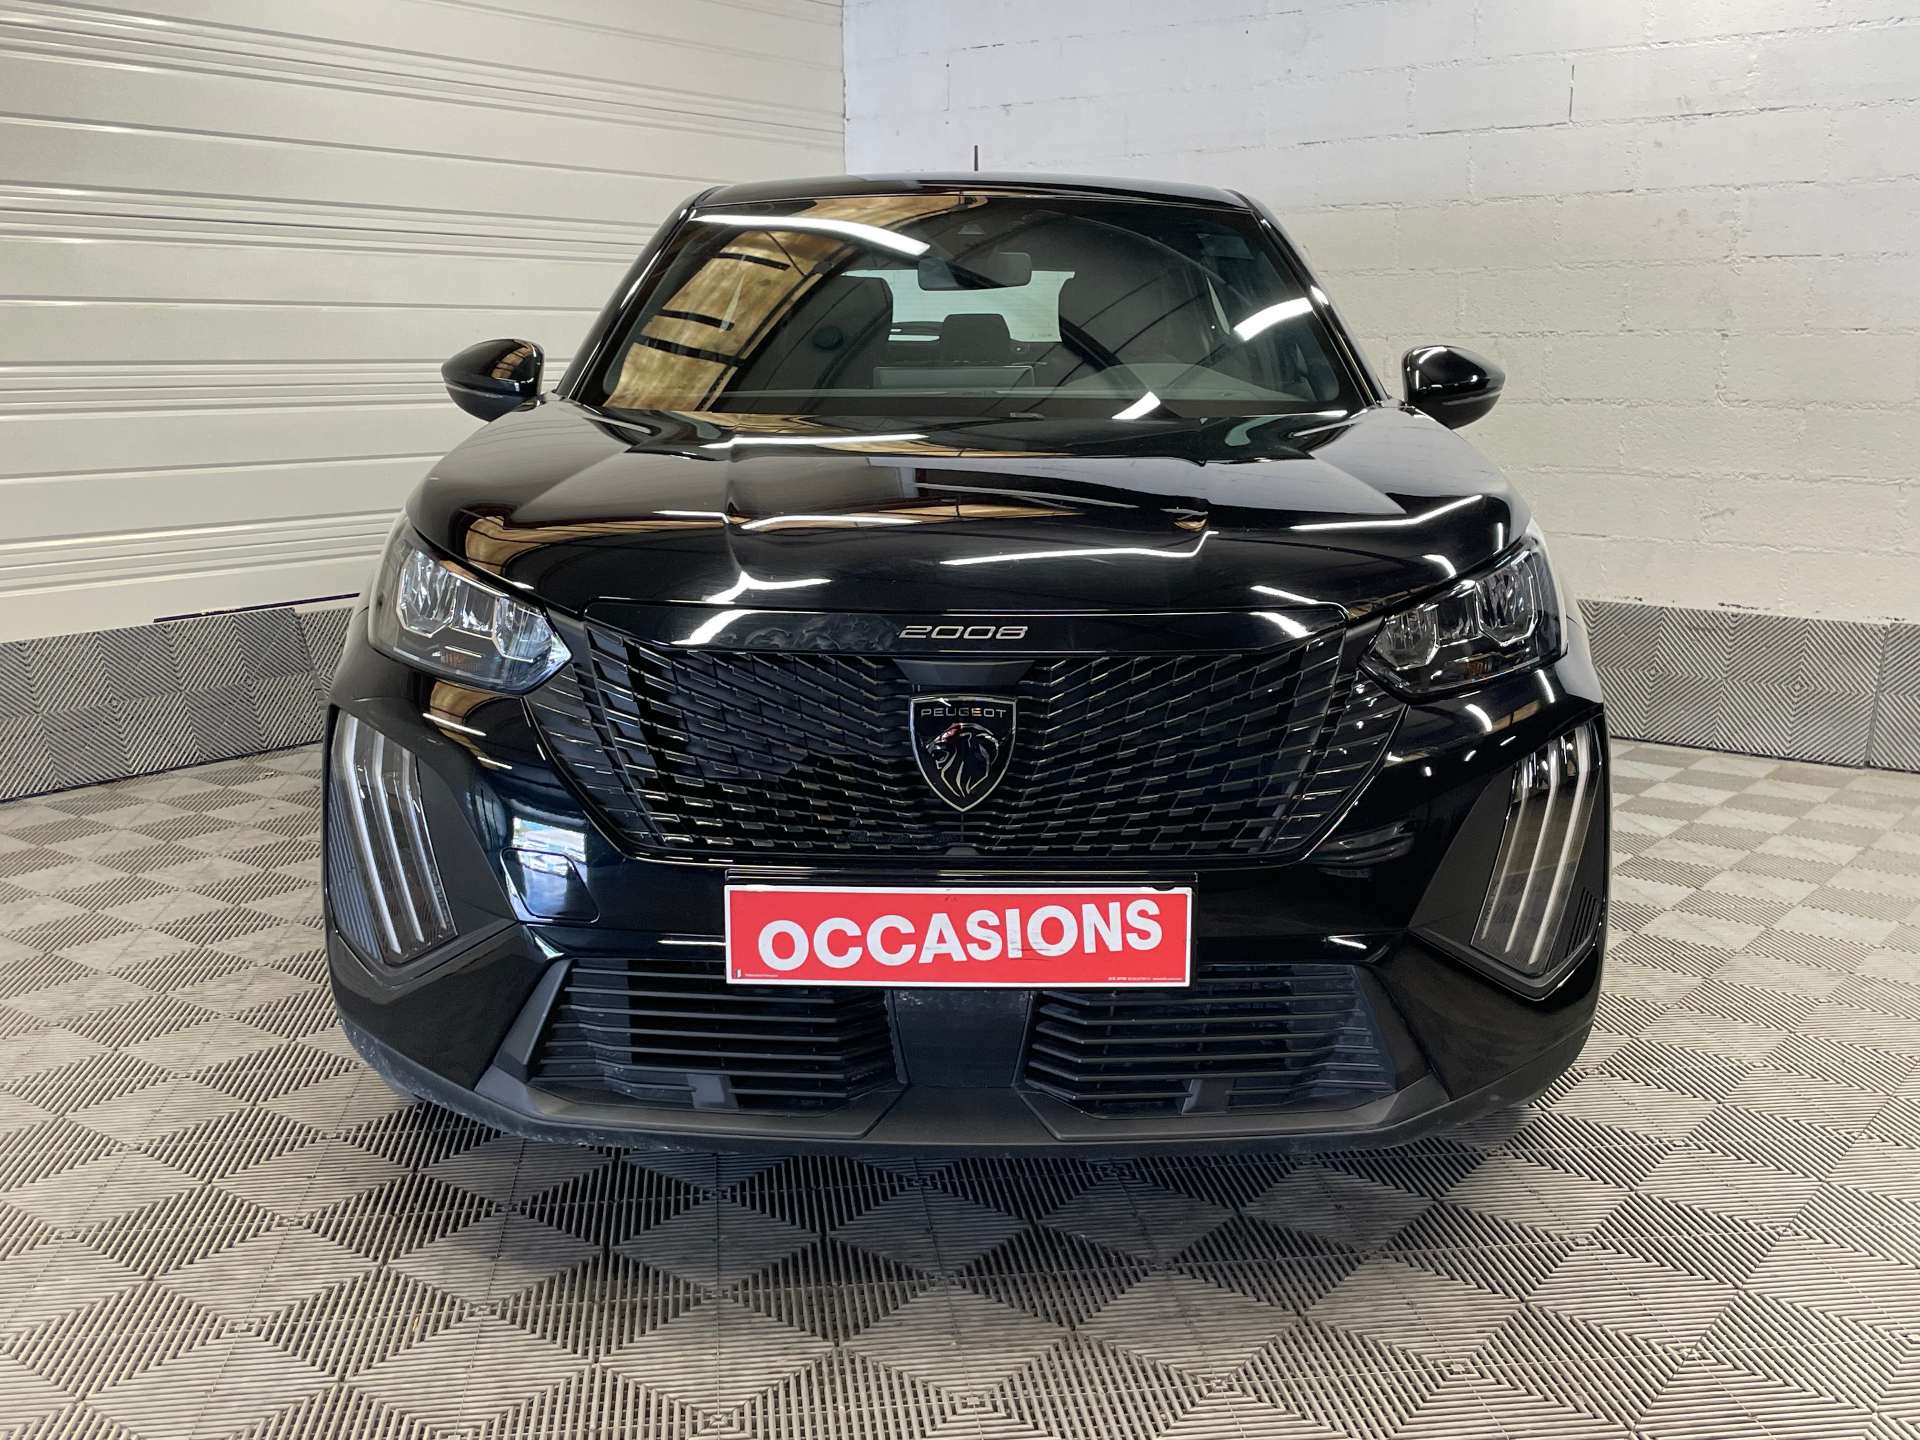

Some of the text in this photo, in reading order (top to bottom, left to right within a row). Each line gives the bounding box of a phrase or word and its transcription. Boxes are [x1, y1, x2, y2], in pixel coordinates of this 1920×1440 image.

[898, 625, 1029, 640] 2008
[920, 707, 1007, 719] PEUGEOT
[757, 898, 1163, 972] OCCASIONS
